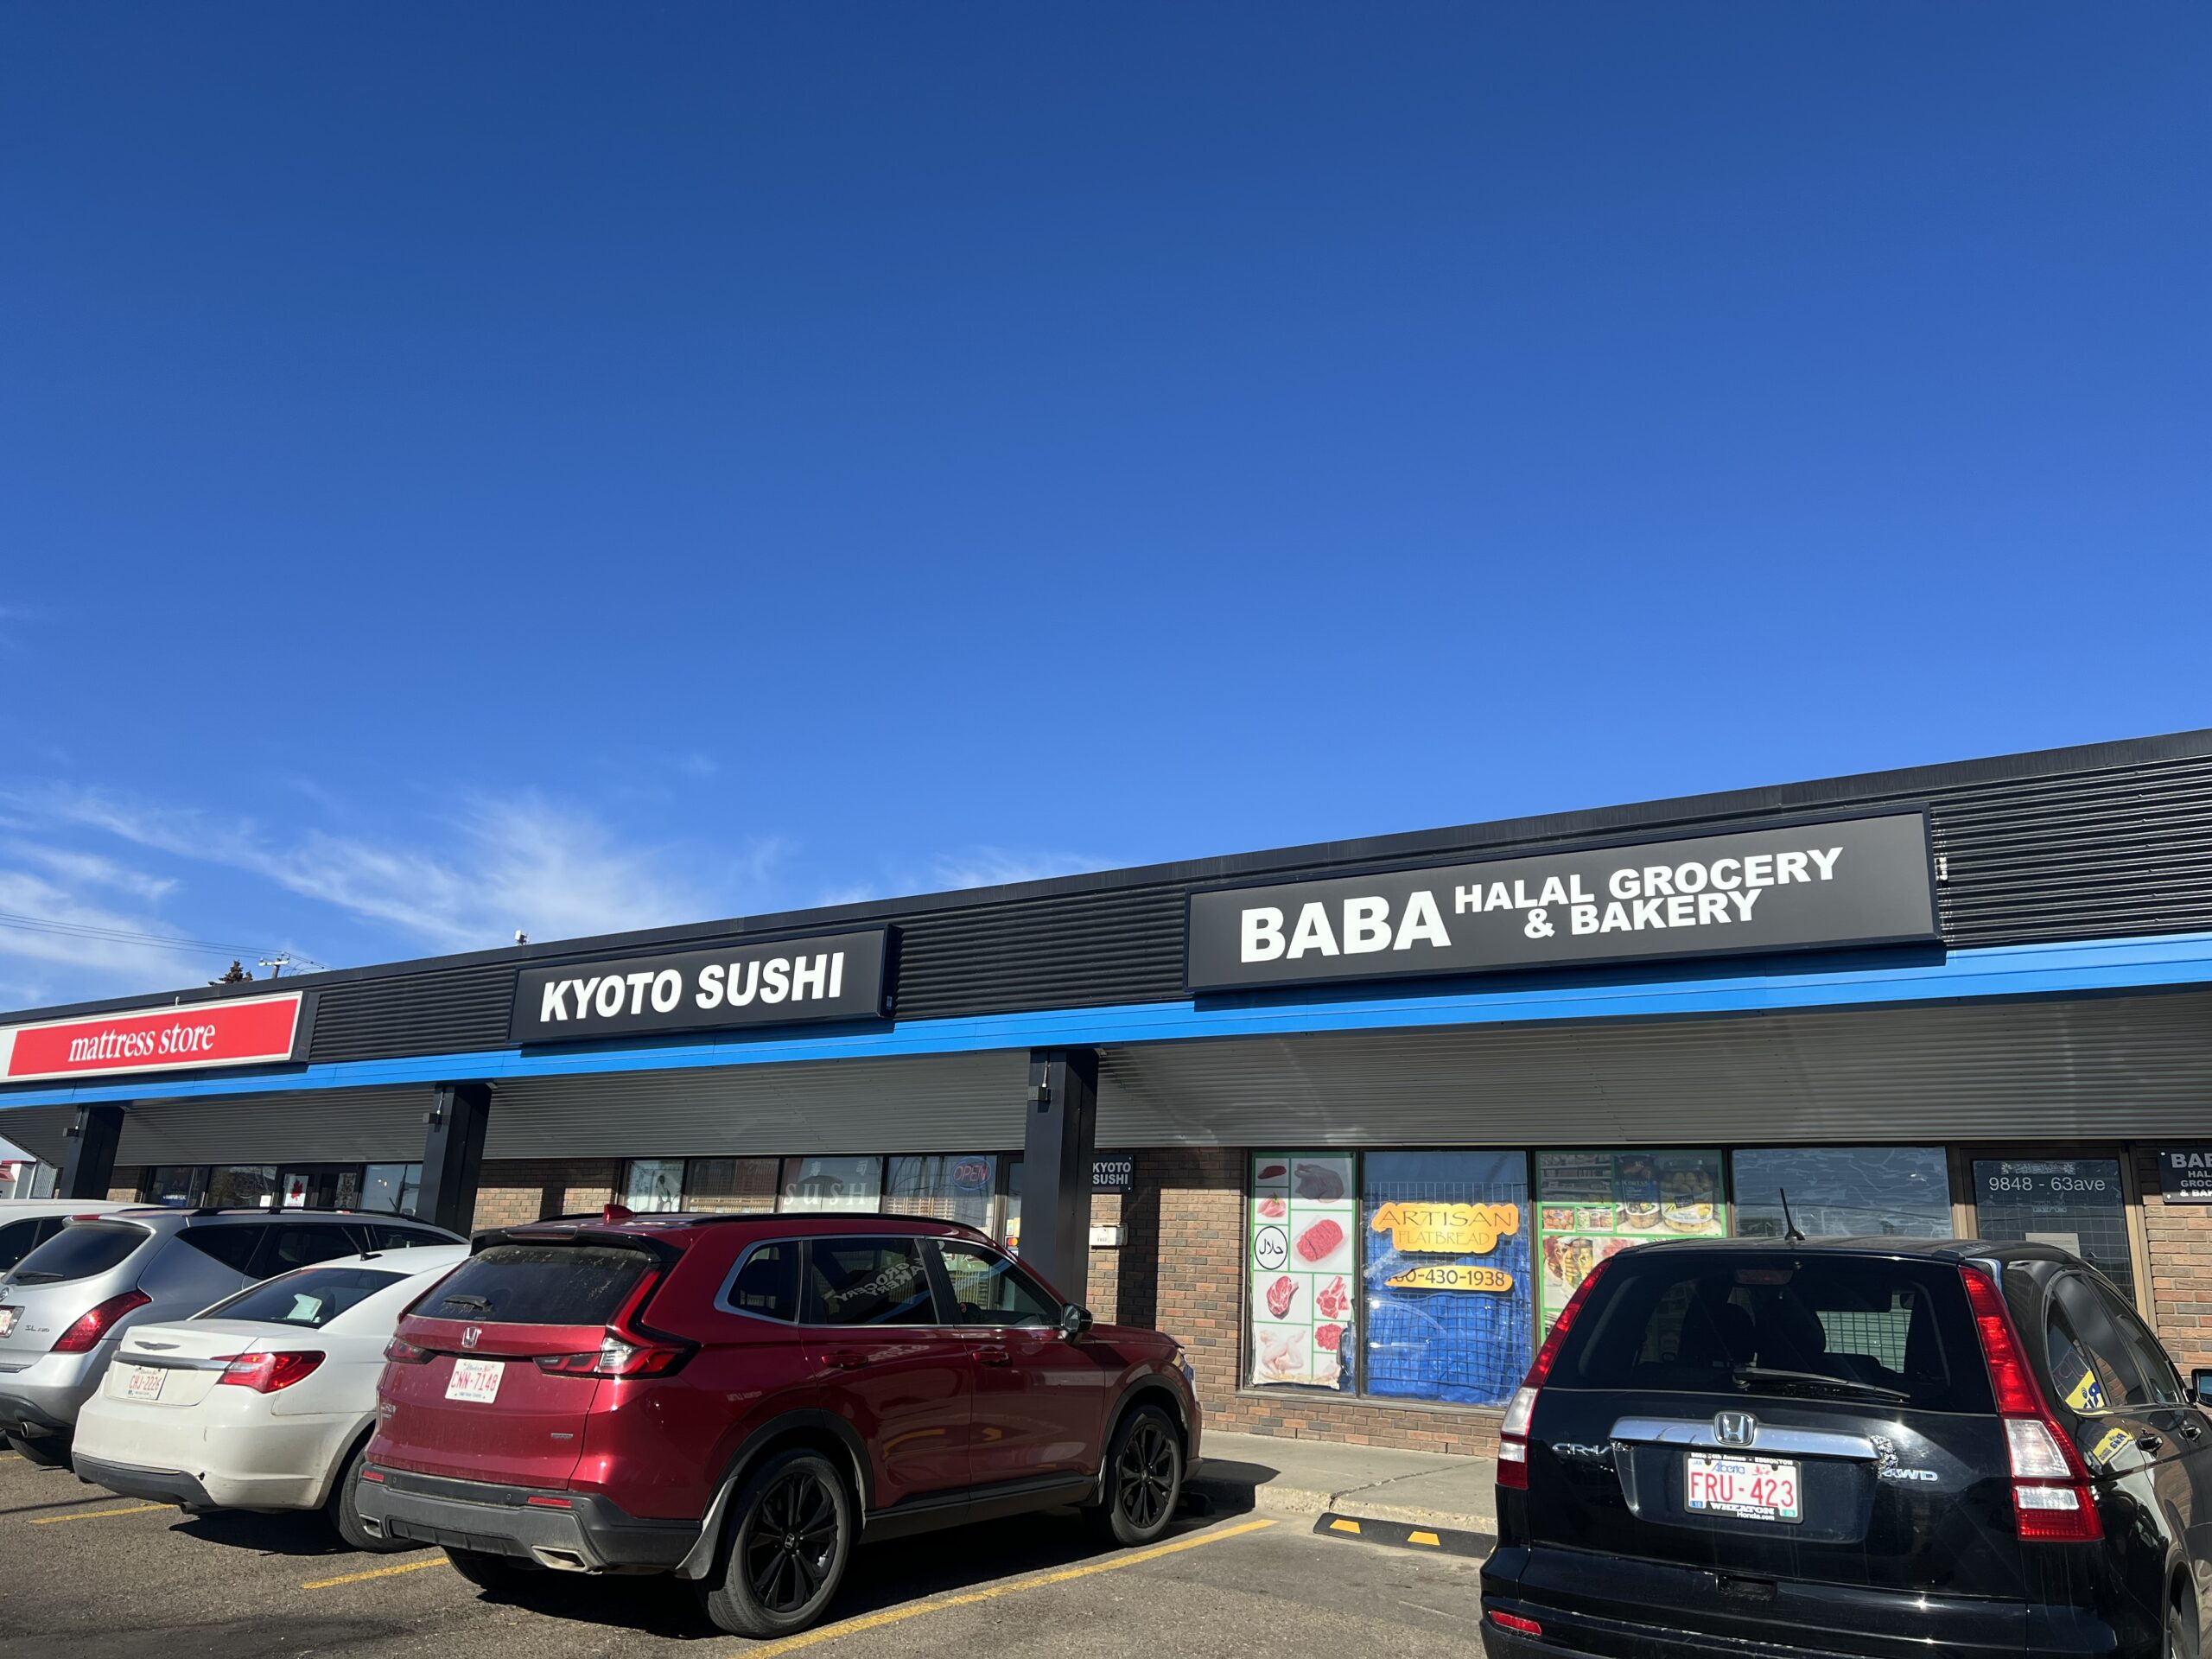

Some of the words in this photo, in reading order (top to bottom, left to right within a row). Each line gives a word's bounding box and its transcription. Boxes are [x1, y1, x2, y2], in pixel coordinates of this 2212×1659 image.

[1240, 890, 1452, 963] BABA
[1454, 874, 1595, 914] HALAL
[1608, 847, 1844, 899] GROCERY
[1523, 908, 1555, 939] &
[1571, 888, 1763, 936] BAKERY
[540, 969, 683, 1023] KYOTO
[695, 951, 845, 1010] SUSHI
[67, 1029, 156, 1063] mattress
[158, 1022, 216, 1055] store
[953, 1165, 987, 1182] OPEN
[1092, 1161, 1131, 1173] KYOTO
[1092, 1173, 1128, 1185] SUSHI
[1989, 1176, 2033, 1192] 9848
[2050, 1176, 2106, 1192] 63ave
[2180, 1179, 2212, 1188] GROC
[1378, 1210, 1512, 1228] ARTISAN
[1258, 1237, 1284, 1255] حلال
[1397, 1230, 1490, 1246] FLATBREAD
[1711, 1460, 1745, 1474] Alberta
[1754, 1457, 1793, 1466] EDMONTON
[1690, 1471, 1795, 1508] FRU-423
[1710, 1502, 1775, 1516] WHEATON
[1737, 1511, 1775, 1521] Honda.com
